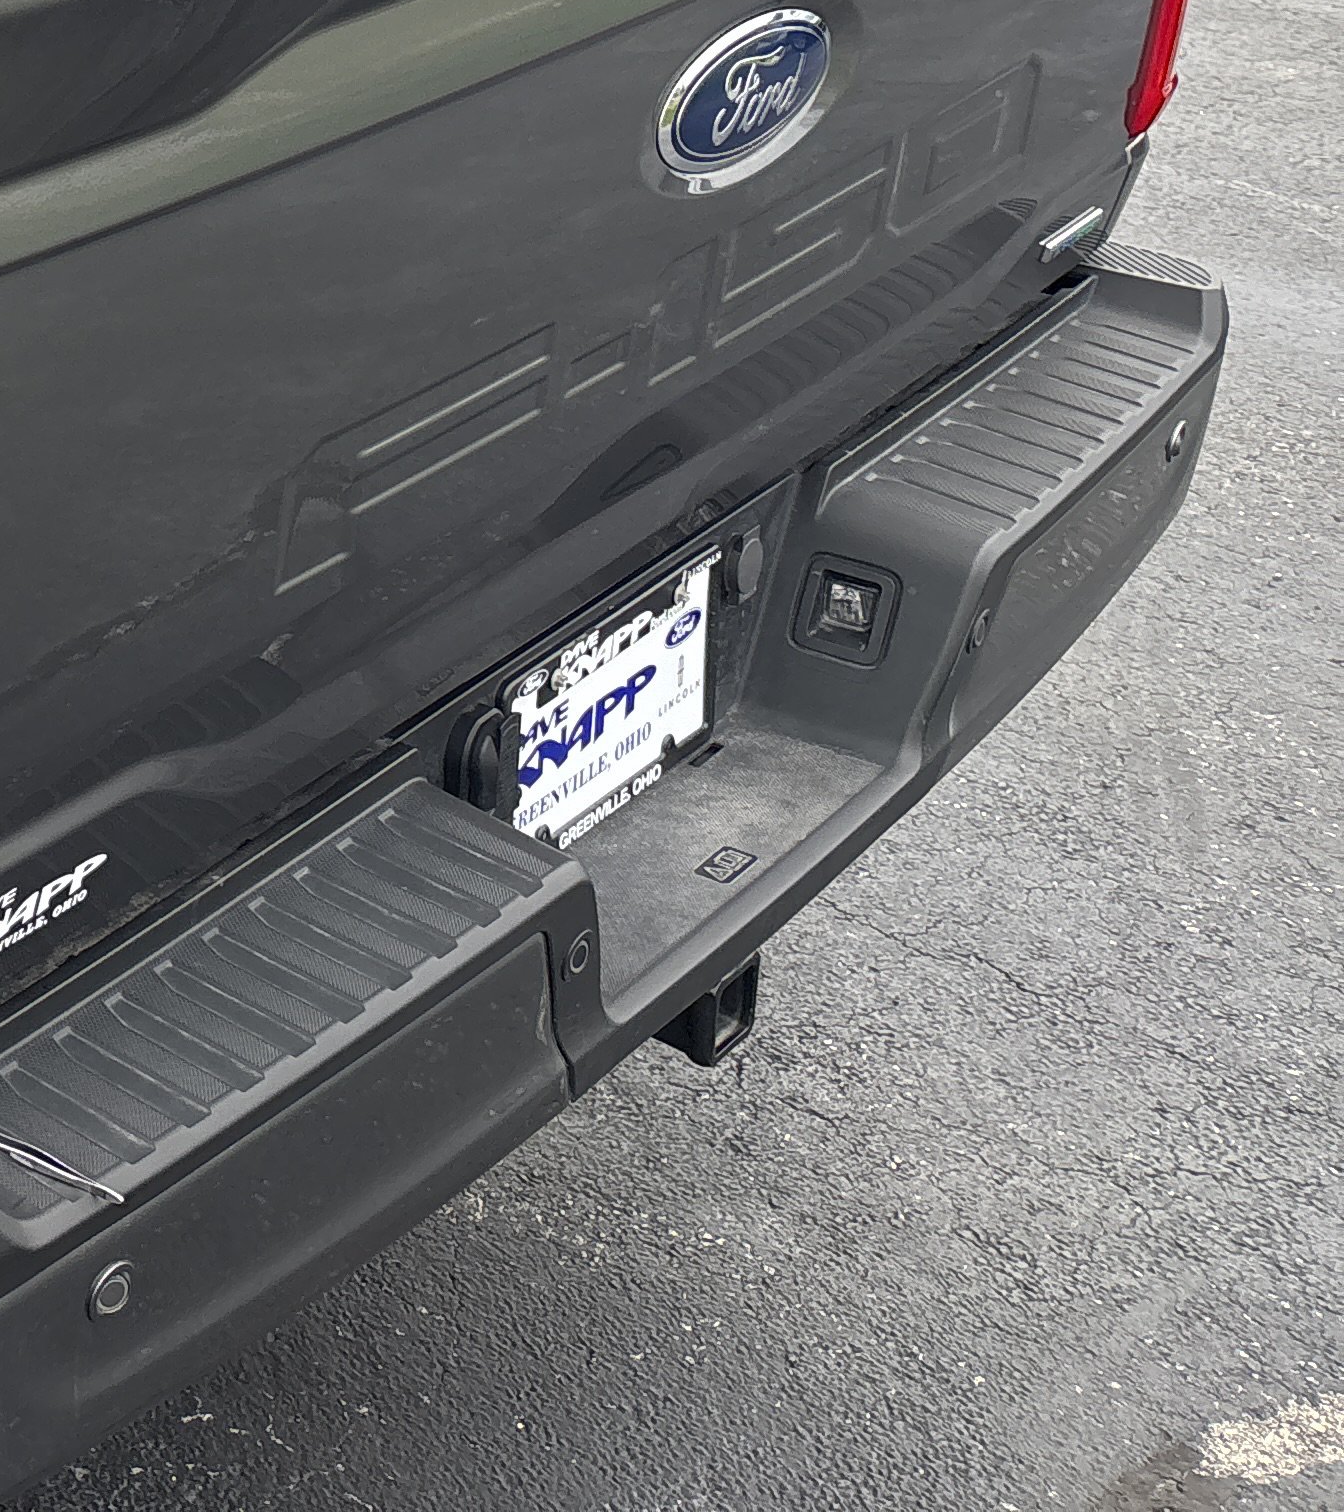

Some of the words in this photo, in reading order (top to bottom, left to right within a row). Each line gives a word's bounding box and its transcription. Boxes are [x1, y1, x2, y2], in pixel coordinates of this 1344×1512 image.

[560, 629, 600, 669] DAVE
[658, 679, 701, 717] LINCOLN
[518, 752, 612, 830] REENVILLE,
[614, 721, 652, 761] OHIO
[632, 763, 662, 796] OHIO
[52, 888, 88, 919] OHIO
